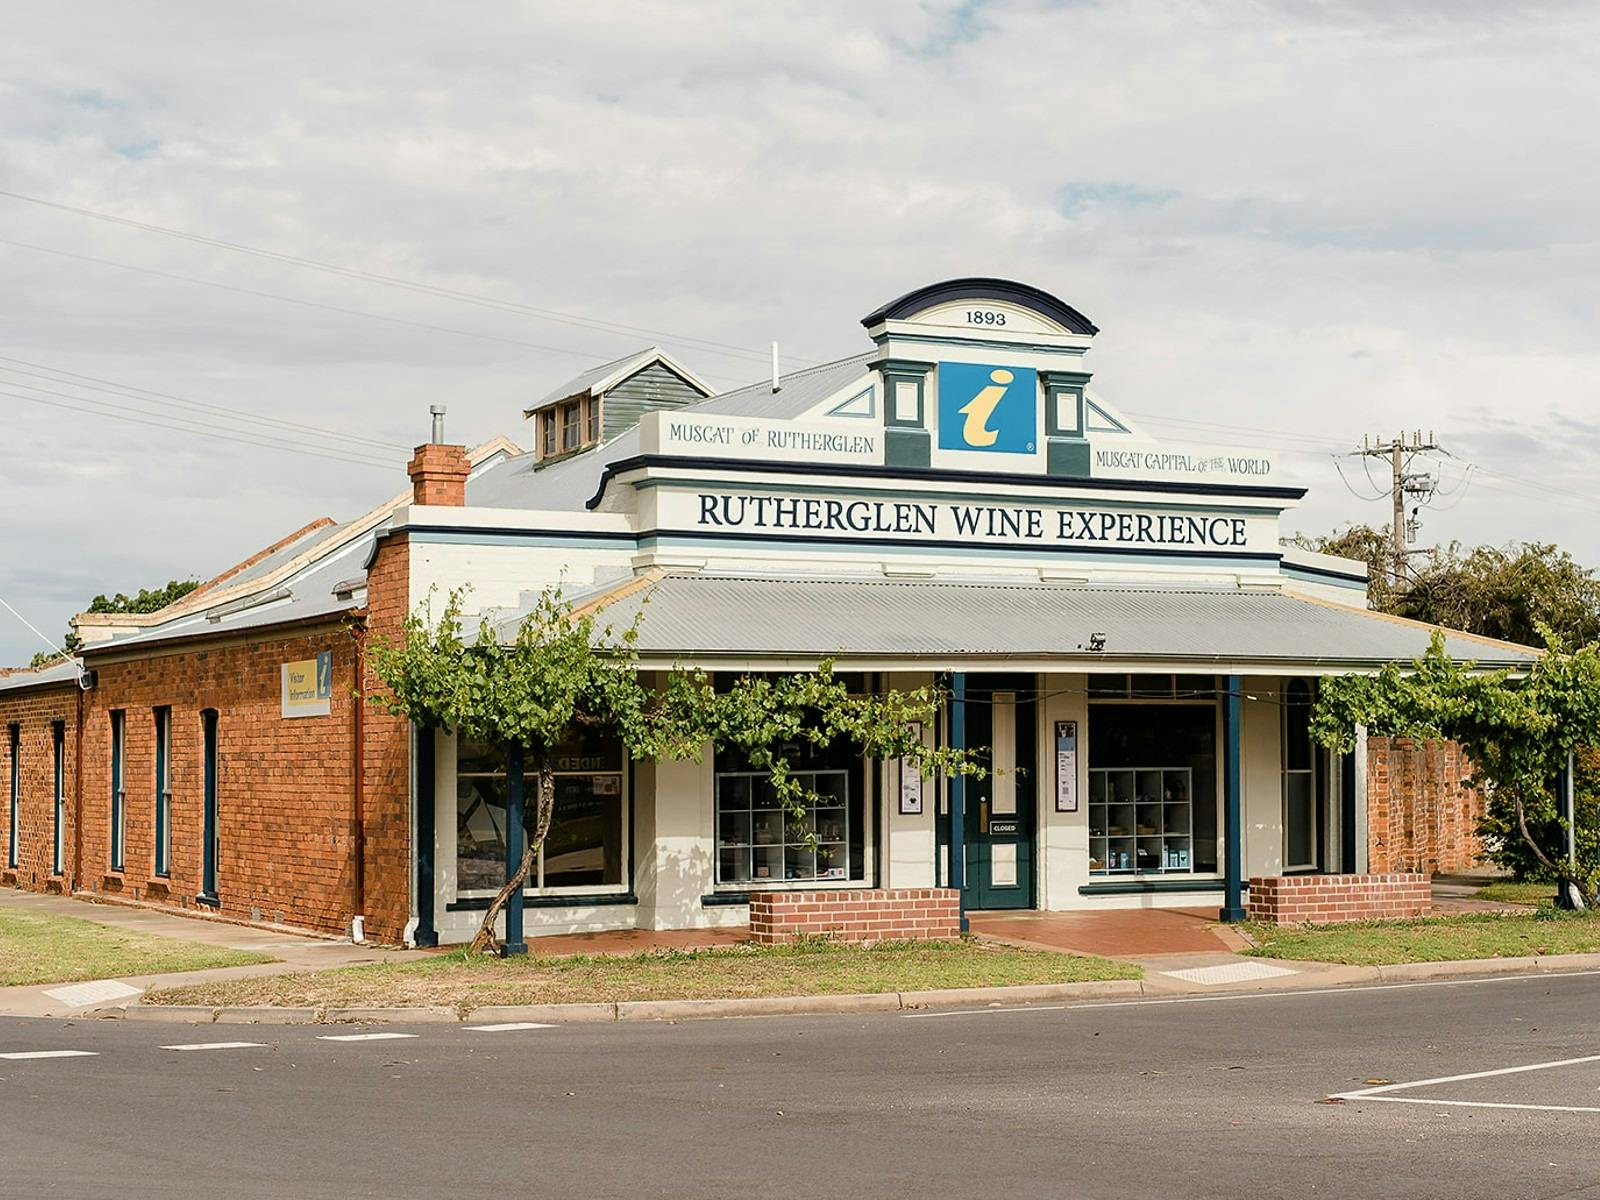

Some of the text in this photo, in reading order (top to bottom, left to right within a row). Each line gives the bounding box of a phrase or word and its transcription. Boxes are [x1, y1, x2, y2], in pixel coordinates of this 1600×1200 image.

[966, 310, 1007, 326] 1893
[669, 423, 734, 445] MUSCAT
[767, 430, 875, 454] RUTHERGLEN
[1096, 451, 1144, 469] MUSCAT
[1144, 453, 1196, 472] CAPITAL
[1227, 457, 1271, 475] WORLD
[697, 494, 1248, 547] RUTHERGLEN WINE EXPERIENCE
